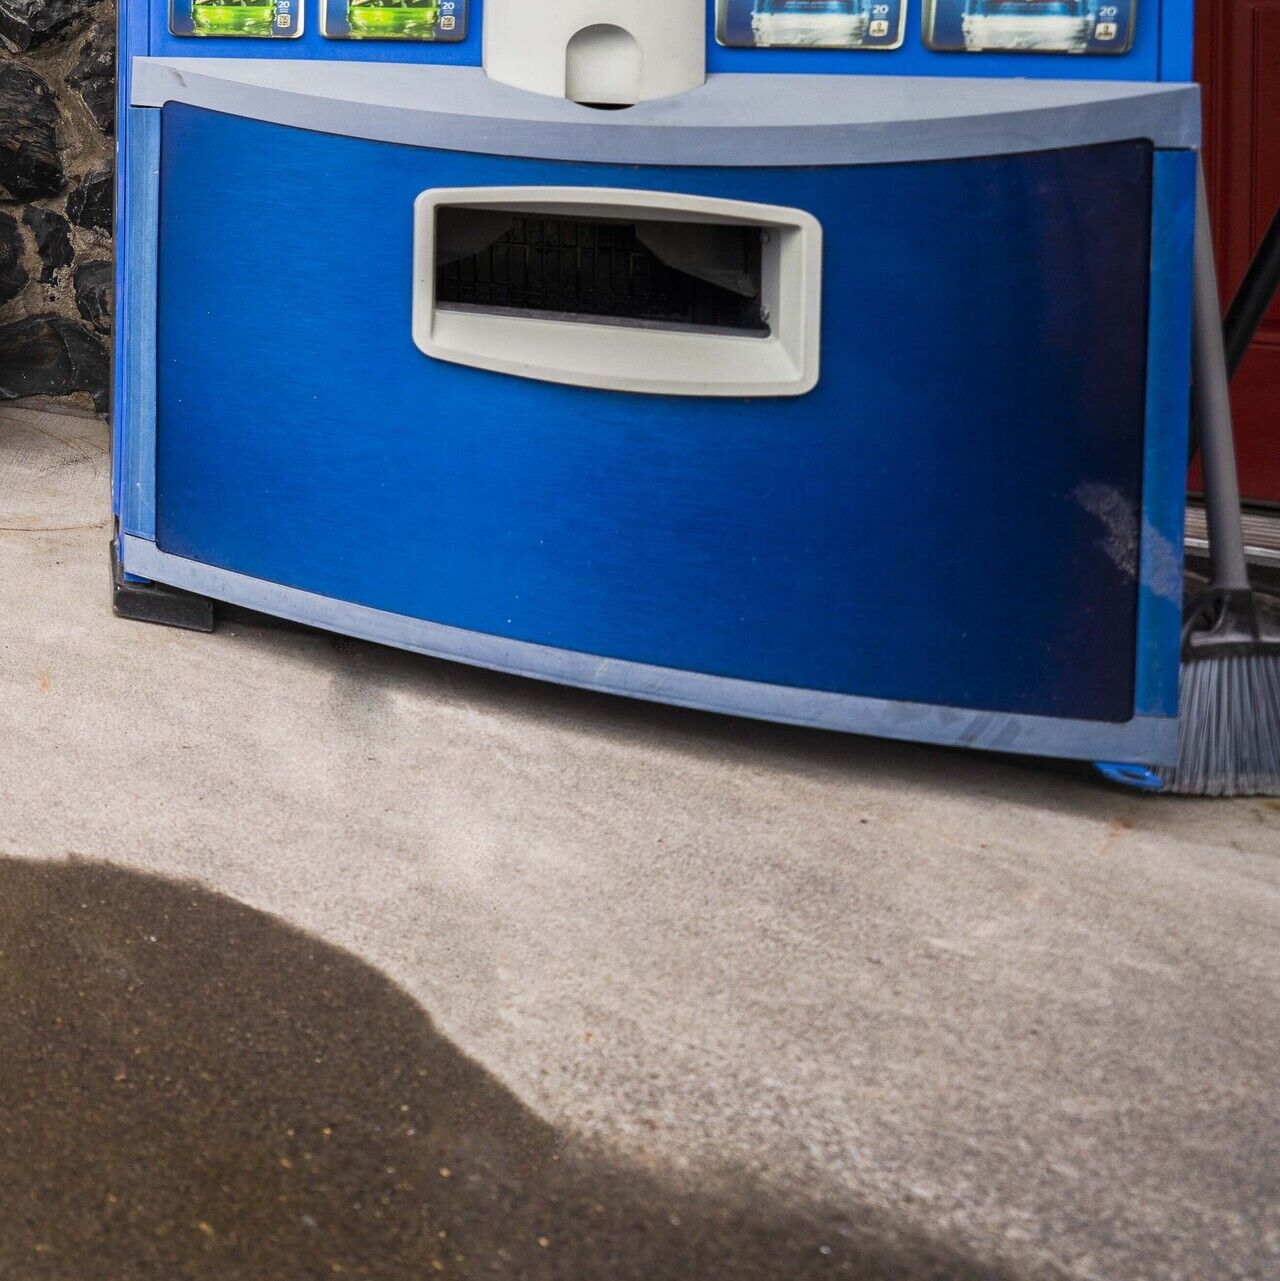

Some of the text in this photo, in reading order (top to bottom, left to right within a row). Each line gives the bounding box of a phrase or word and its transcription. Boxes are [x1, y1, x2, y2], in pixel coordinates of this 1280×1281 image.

[278, 0, 290, 8] 20
[442, 2, 455, 10] 20
[872, 4, 889, 14] 20
[1099, 6, 1118, 16] 20
